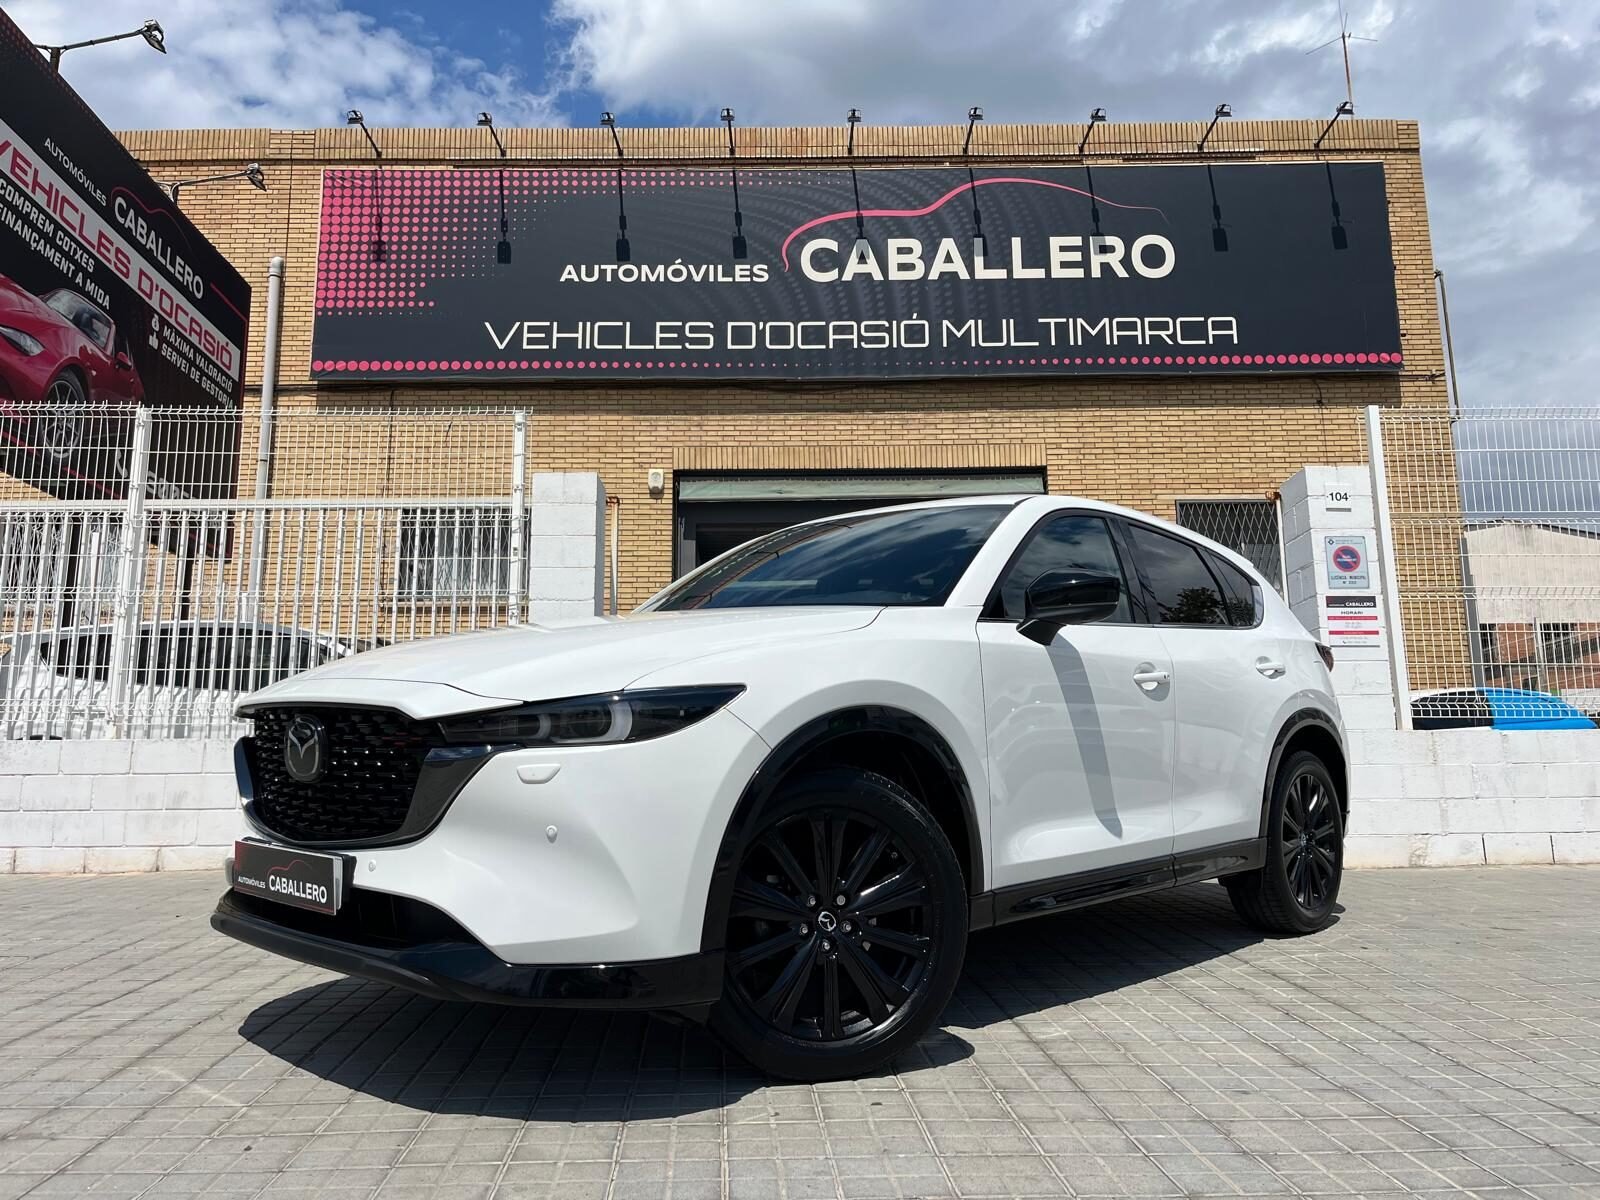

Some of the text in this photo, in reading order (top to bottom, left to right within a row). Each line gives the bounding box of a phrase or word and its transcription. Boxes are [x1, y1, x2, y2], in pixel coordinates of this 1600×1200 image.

[0, 178, 95, 274] COMPREM COTXES
[44, 137, 204, 299] AUTOMÓVILES CABALLERO
[559, 234, 1176, 283] AUTOMÓVILES CABALLERO
[75, 271, 83, 287] A
[85, 277, 111, 310] MIDA
[137, 267, 232, 372] D'OCASIÓ
[484, 313, 1238, 350] VEHICLES D'OCASIÓ MULTIMARCA
[161, 343, 189, 374] SERVEI
[190, 365, 200, 384] DE
[195, 352, 233, 393] VALORACIÓ
[1328, 492, 1349, 502] 104
[238, 875, 328, 903] AUTOMÓVILES CABALLERO
